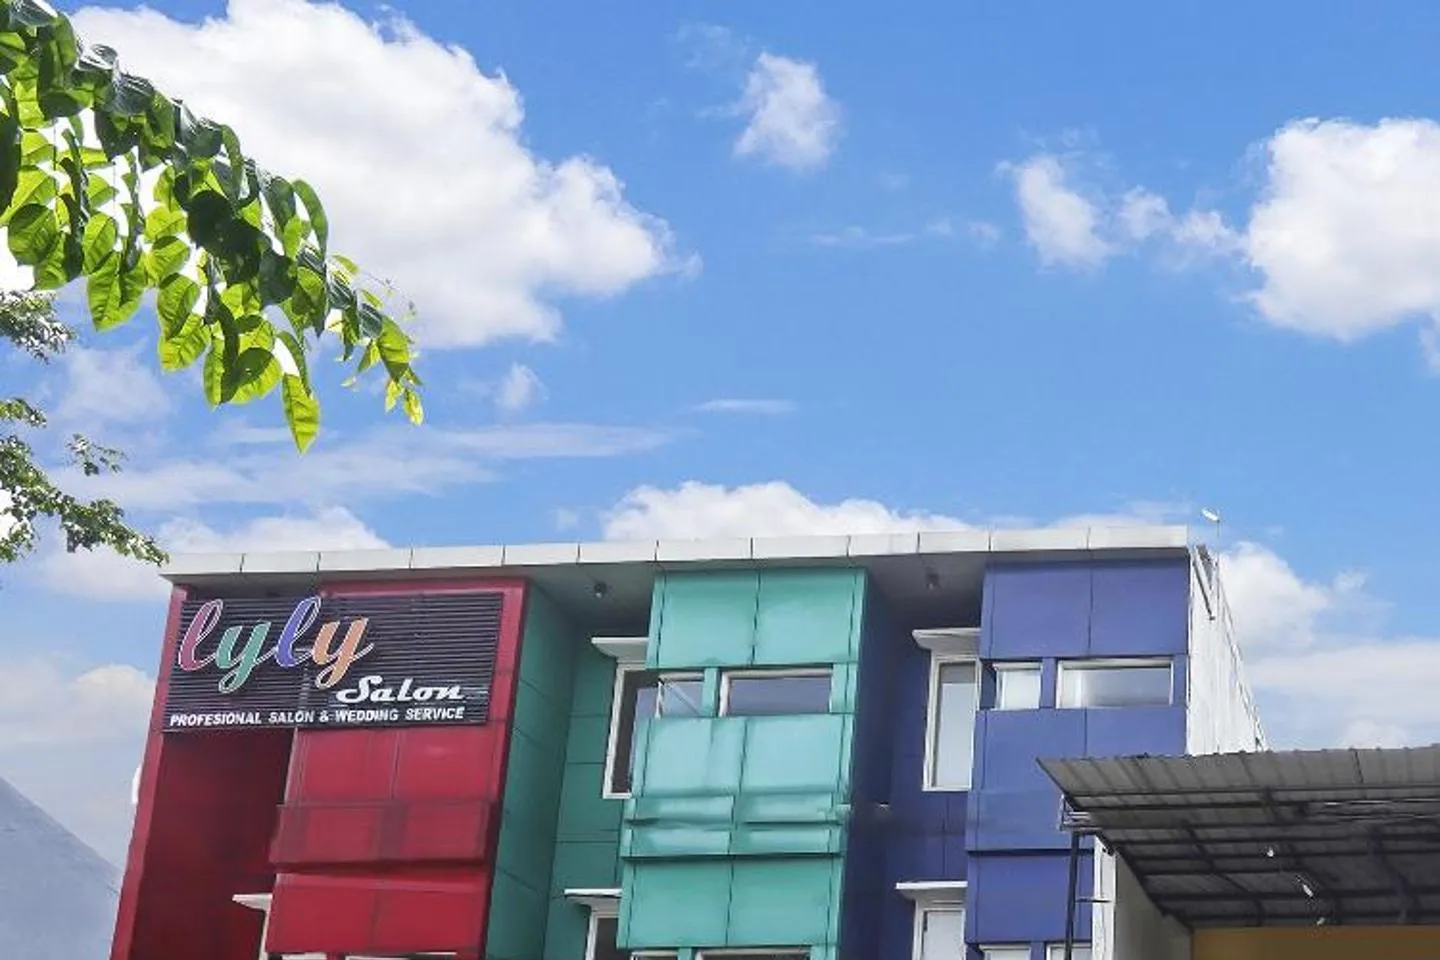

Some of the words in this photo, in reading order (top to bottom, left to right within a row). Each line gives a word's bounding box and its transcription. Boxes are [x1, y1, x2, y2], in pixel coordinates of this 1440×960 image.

[336, 675, 467, 703] Salon
[169, 712, 262, 726] PROFESIONAL
[268, 710, 315, 723] SALON
[319, 710, 329, 722] &
[335, 708, 399, 722] WEDDING
[405, 706, 466, 720] SERVICE
